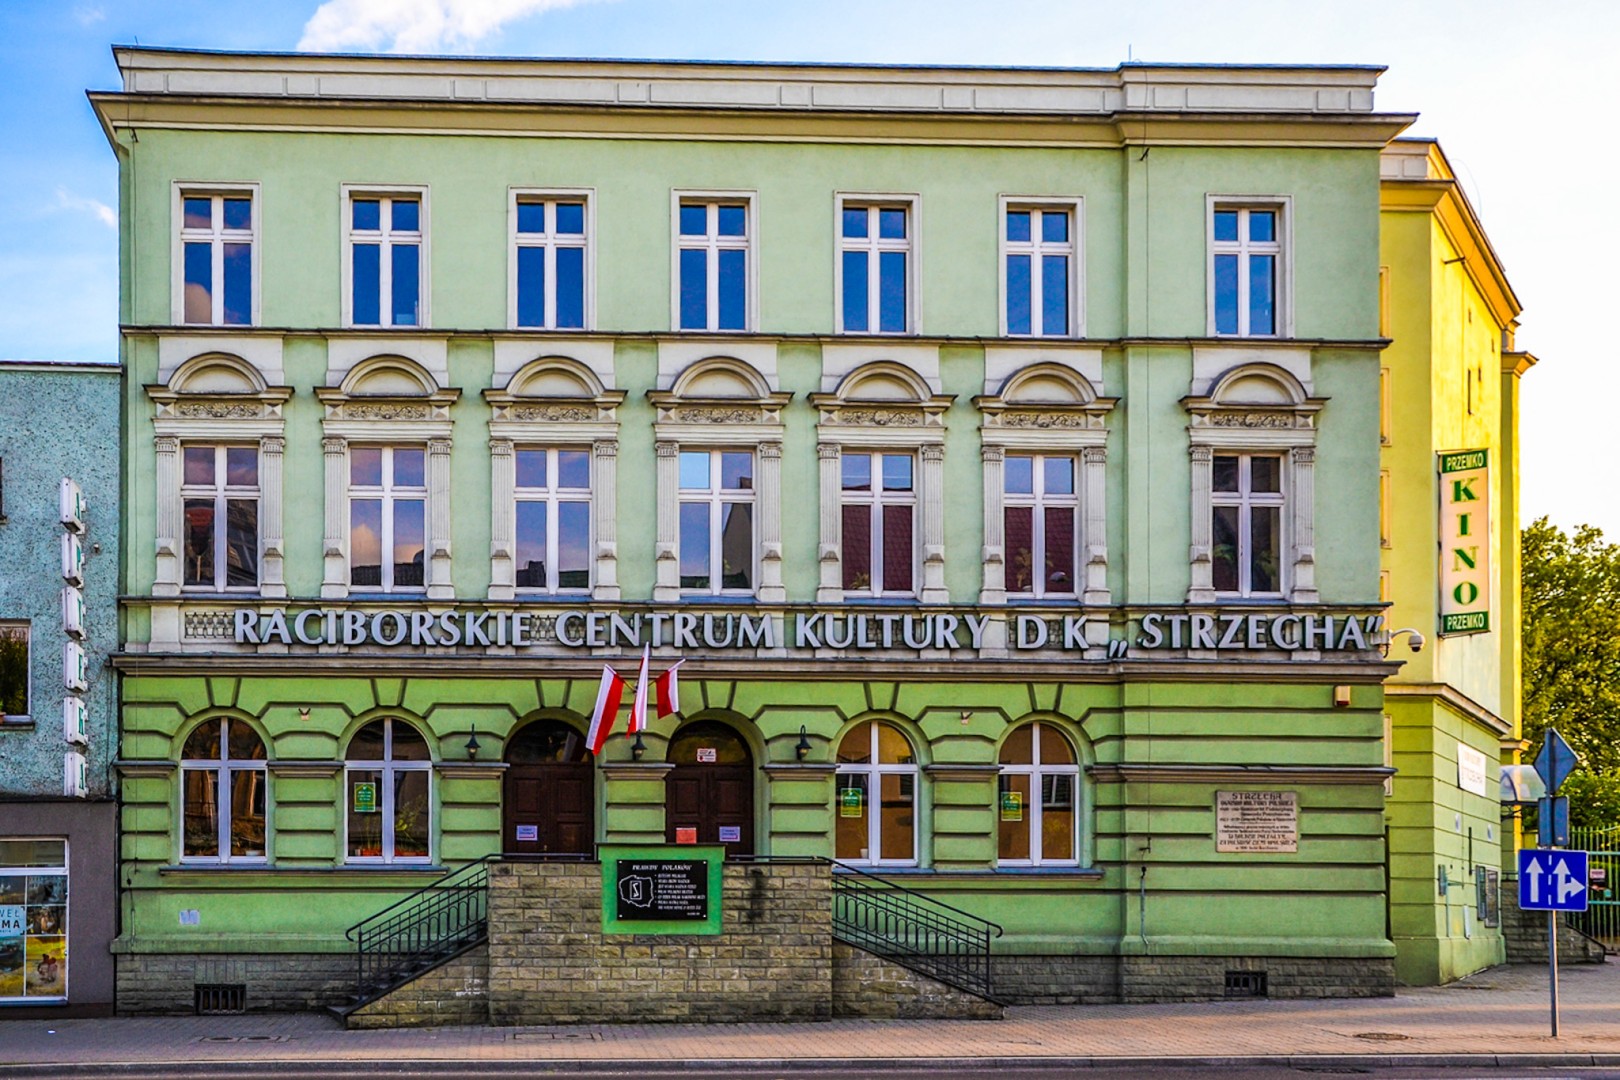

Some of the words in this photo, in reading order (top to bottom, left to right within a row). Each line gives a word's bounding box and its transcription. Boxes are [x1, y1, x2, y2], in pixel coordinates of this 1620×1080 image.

[1446, 452, 1484, 471] PRZEMKO
[1449, 477, 1480, 606] KINO
[234, 608, 532, 647] RACIBORSKIE
[555, 610, 775, 649] CENTRUM
[795, 612, 991, 650] KULTURY
[1446, 617, 1485, 631] PRZEMKO
